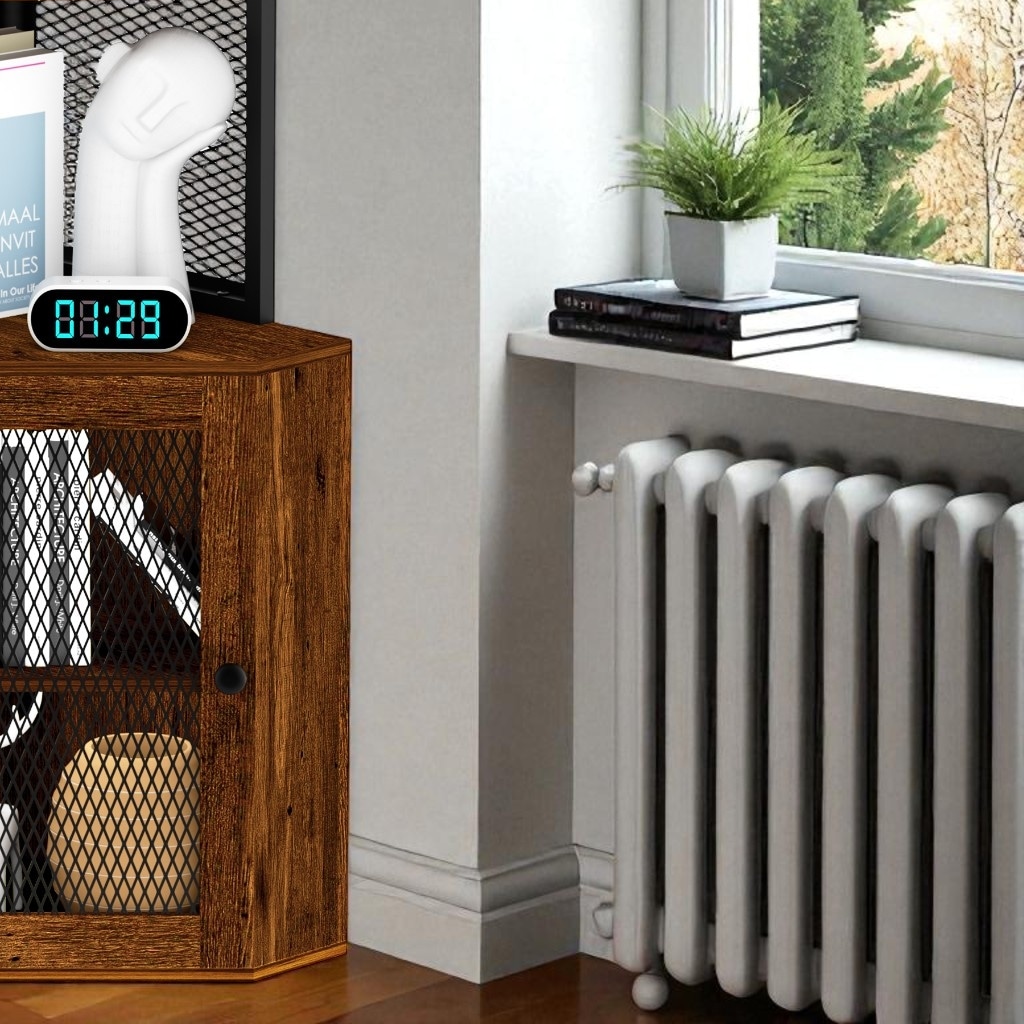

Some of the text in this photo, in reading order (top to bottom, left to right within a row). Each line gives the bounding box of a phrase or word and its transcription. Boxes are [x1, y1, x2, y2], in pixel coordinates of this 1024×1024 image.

[0, 289, 8, 298] In
[10, 286, 25, 296] Our
[26, 282, 36, 294] Lif
[55, 299, 161, 340] 01:29
